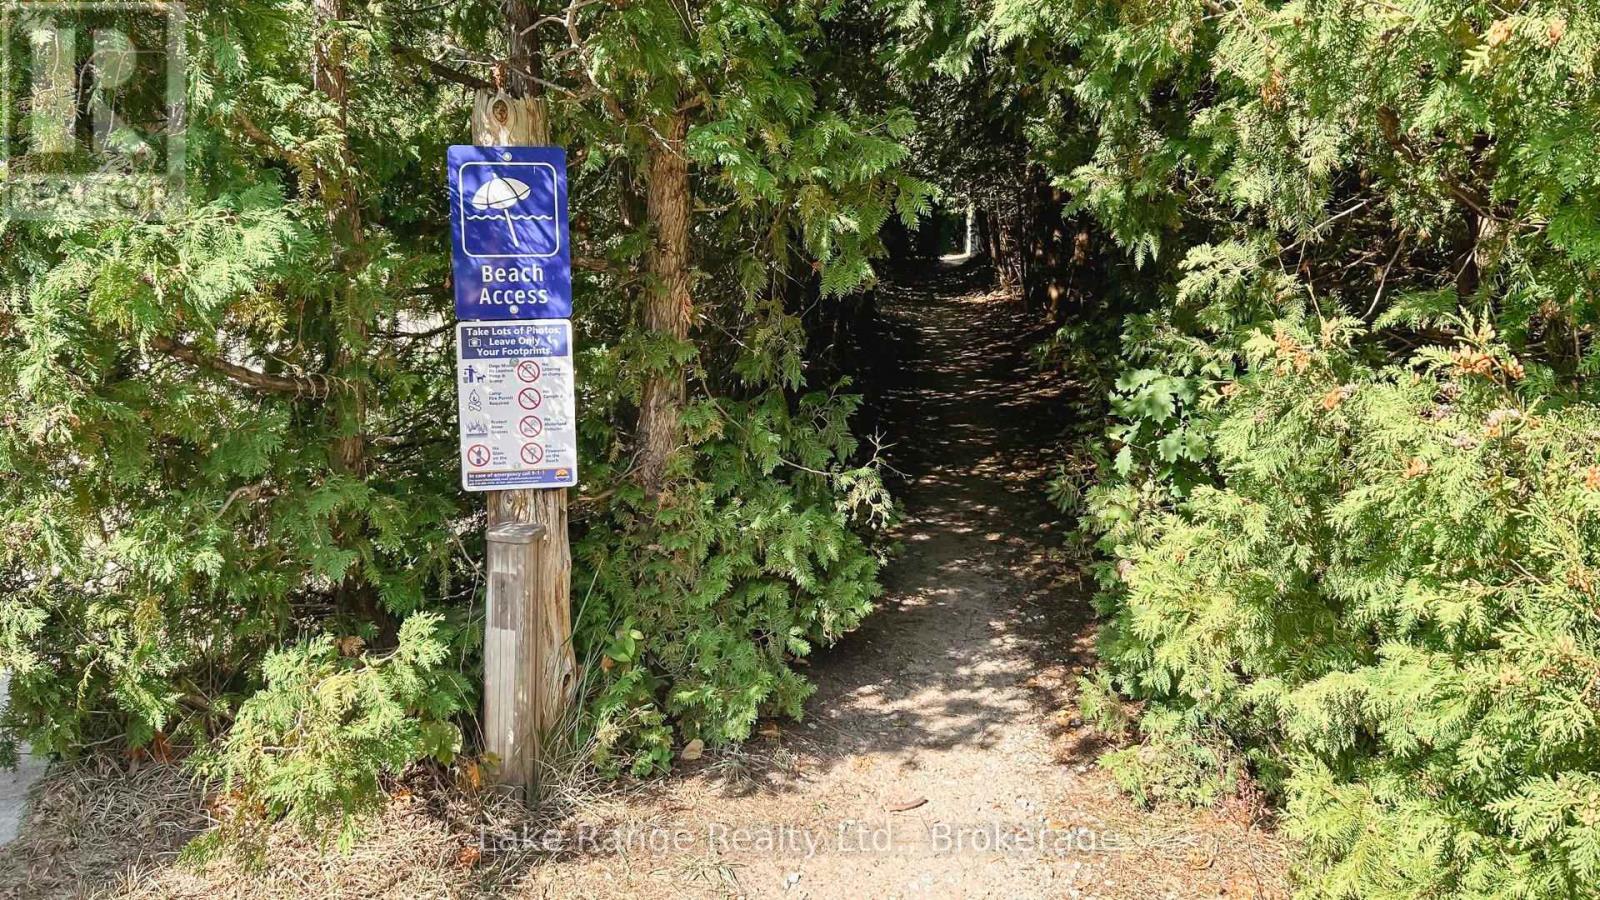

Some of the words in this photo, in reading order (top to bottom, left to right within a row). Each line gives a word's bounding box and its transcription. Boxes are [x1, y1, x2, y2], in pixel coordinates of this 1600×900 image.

[481, 264, 544, 282] Beach
[479, 288, 548, 305] Access
[466, 328, 489, 336] Take
[492, 327, 511, 335] Lots
[490, 338, 516, 346] Leave
[518, 337, 541, 347] Only
[477, 348, 499, 356] Your
[502, 347, 553, 356] Footprints.
